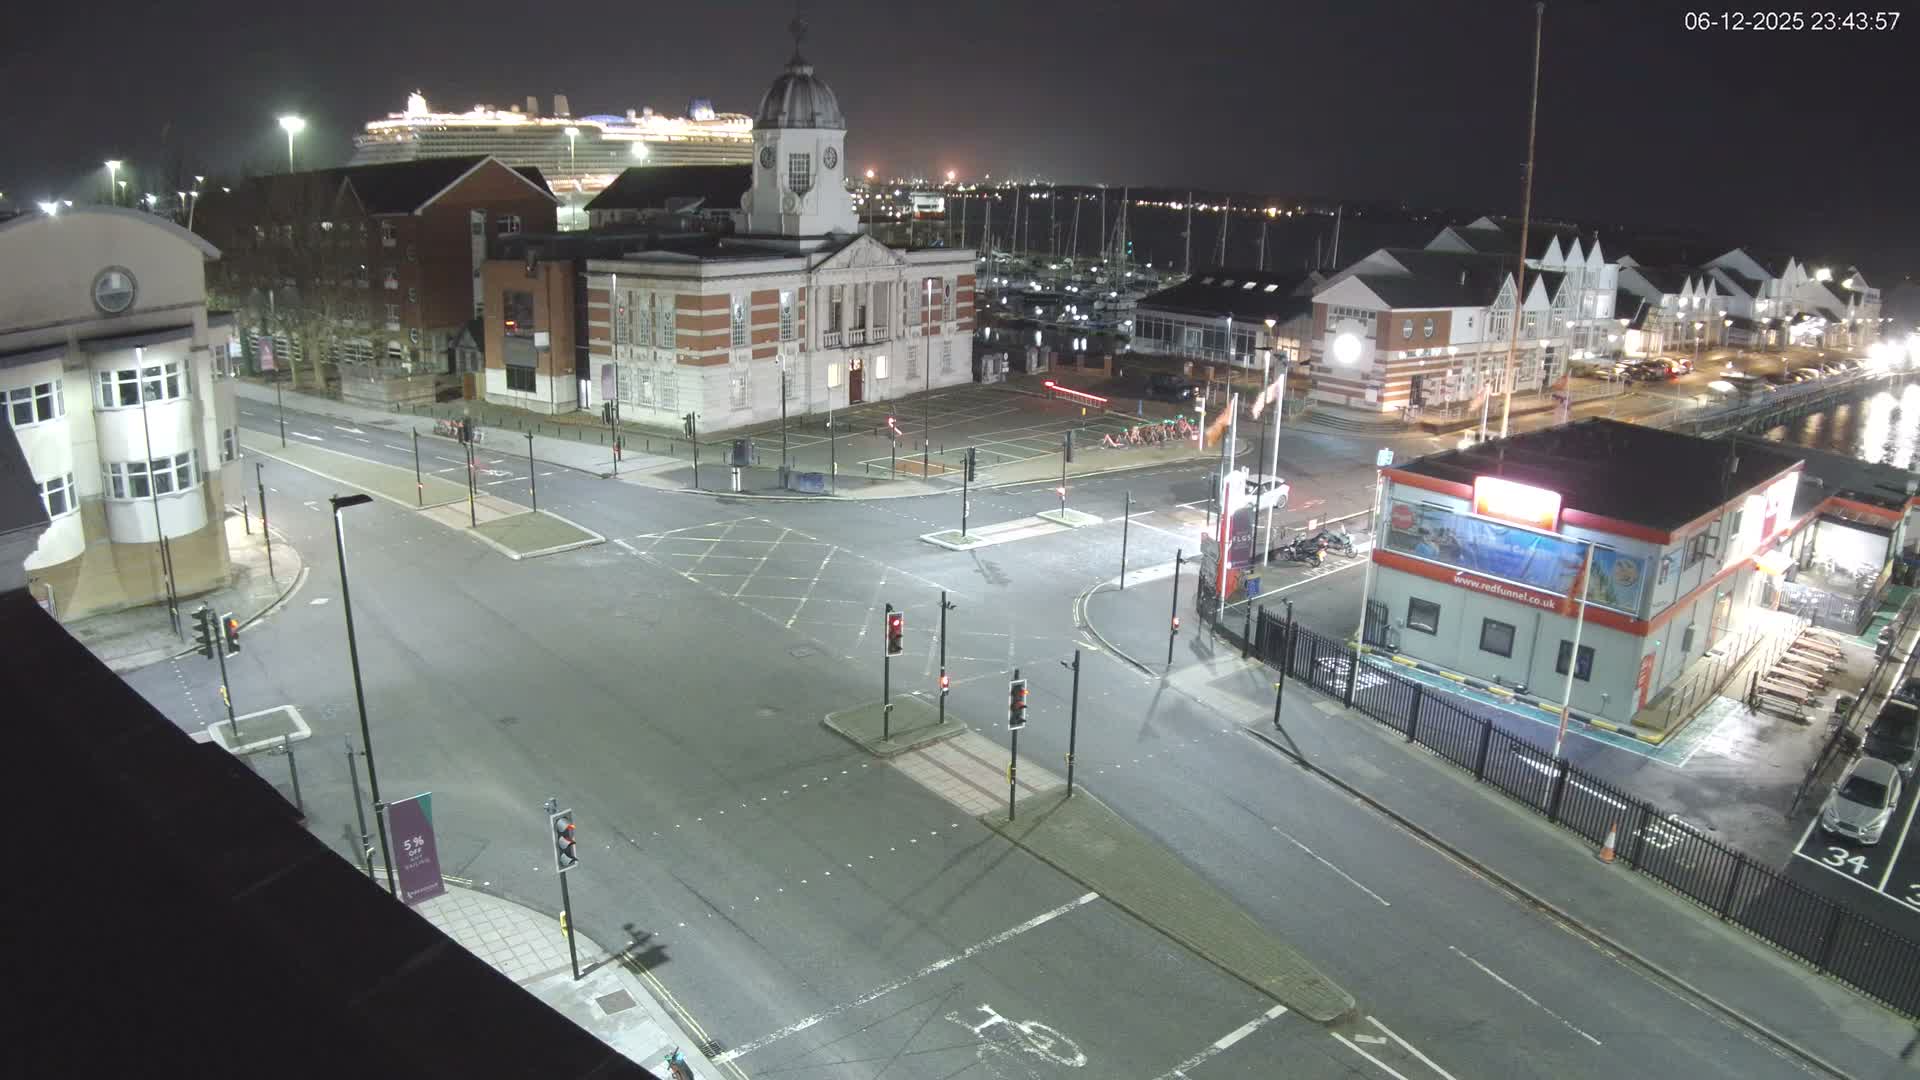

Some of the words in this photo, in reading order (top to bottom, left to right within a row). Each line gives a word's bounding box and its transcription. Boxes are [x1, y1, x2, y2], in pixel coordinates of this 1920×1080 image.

[1453, 575, 1556, 610] www.redfunnel.co.uk
[408, 847, 422, 857] OFF
[1822, 846, 1869, 875] 34
